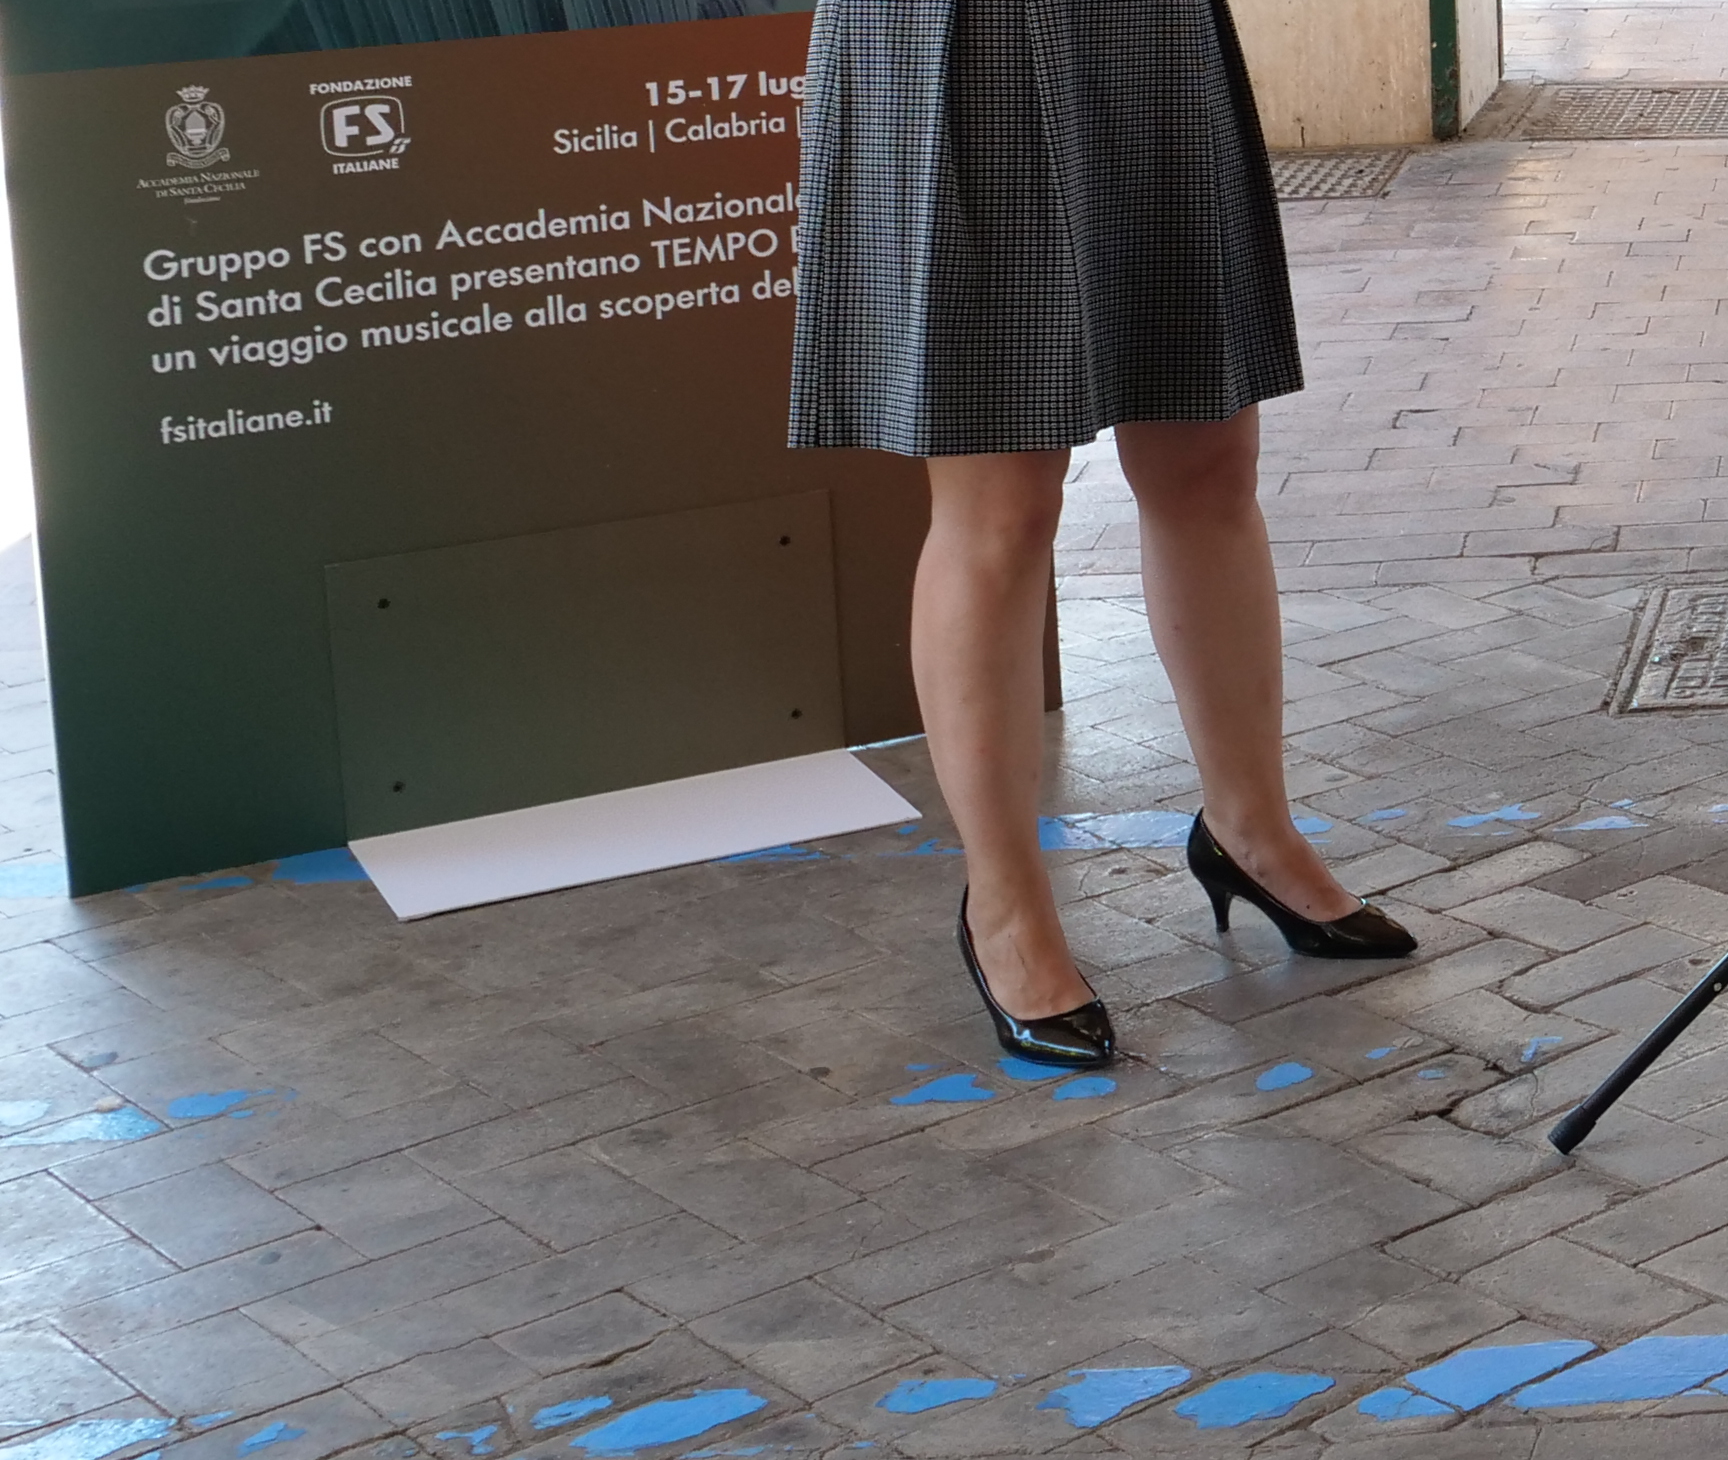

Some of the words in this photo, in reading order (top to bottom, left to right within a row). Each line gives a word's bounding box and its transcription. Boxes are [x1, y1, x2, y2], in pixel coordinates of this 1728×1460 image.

[309, 75, 413, 95] FONDAZIONE
[645, 73, 748, 107] 15-17
[758, 69, 808, 100] lug
[332, 103, 396, 148] FS
[553, 127, 638, 155] Sicilia
[665, 112, 786, 144] Calabria
[332, 157, 400, 176] ITALIANE
[143, 243, 292, 284] Gruppo
[302, 231, 346, 266] FS
[358, 231, 423, 262] con
[436, 204, 631, 251] Accademia
[147, 292, 182, 328] di
[195, 281, 302, 323] Santa
[315, 268, 438, 310] Cecilia
[449, 251, 641, 303] presentano
[650, 228, 779, 271] TEMPO
[151, 345, 197, 375] un
[208, 325, 348, 368] viaggio
[360, 302, 513, 350] musicale
[524, 297, 588, 329] alla
[597, 279, 741, 323] scoperta
[160, 399, 333, 446] fsitaliane.it
